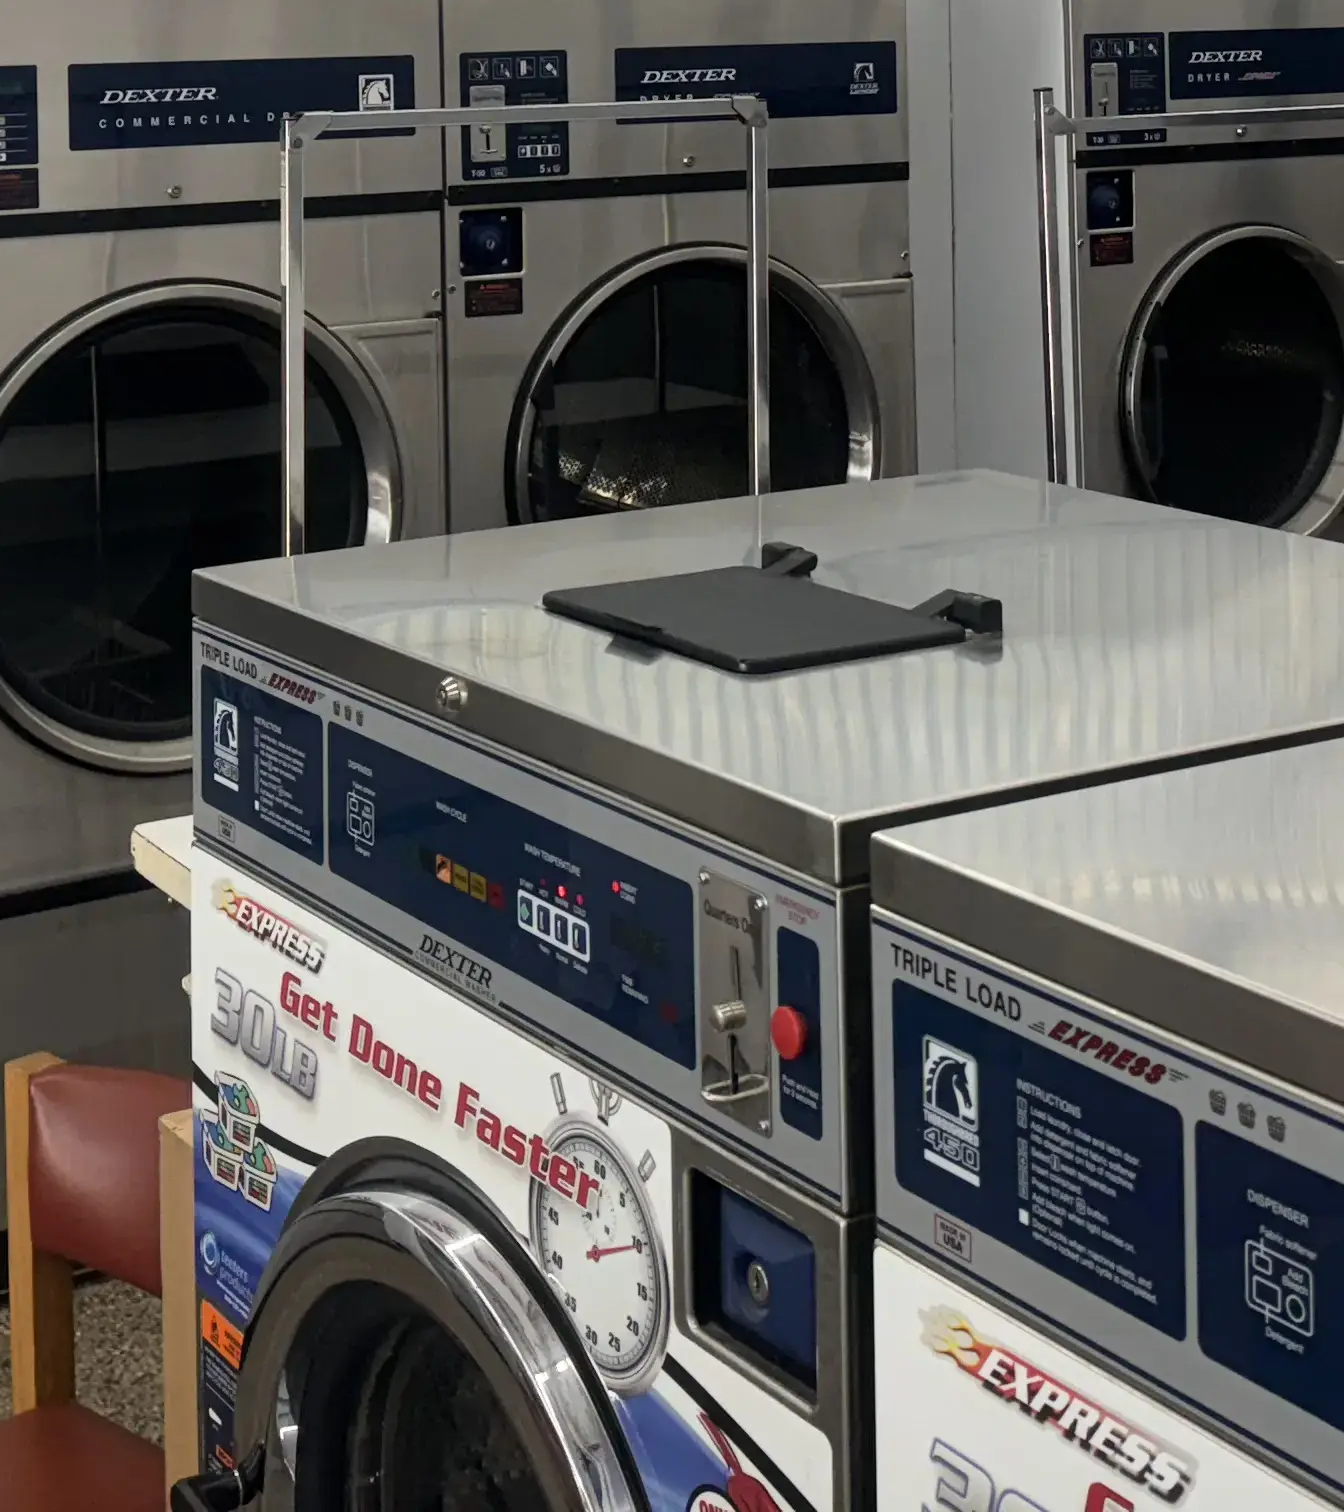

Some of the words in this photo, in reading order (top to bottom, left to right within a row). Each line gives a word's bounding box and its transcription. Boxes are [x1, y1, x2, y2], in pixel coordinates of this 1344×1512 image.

[1188, 50, 1263, 63] DEXTER
[640, 68, 737, 84] DEXTER
[1188, 73, 1230, 83] DRYER
[99, 86, 219, 105] DEXTER
[98, 112, 251, 130] COMMERCIAL
[200, 641, 230, 668] TRIPLE
[232, 655, 258, 679] LOAD
[267, 673, 318, 705] EXPRESS
[235, 898, 326, 973] EXPRESS
[419, 934, 492, 989] DEXTER
[415, 950, 463, 985] COMMERCIAL
[465, 979, 497, 1002] WASHER
[890, 942, 958, 996] TRIPLE
[964, 976, 1022, 1023] LOAD
[1047, 1019, 1169, 1086] EXPRESS
[210, 966, 319, 1100] 30LB
[280, 971, 339, 1042] Get
[348, 1013, 443, 1112] Done
[455, 1082, 600, 1209] Faster
[1016, 1078, 1082, 1119] INSTRUCTIONS
[924, 1126, 980, 1173] 450
[594, 1159, 606, 1180] 60
[619, 1192, 626, 1208] 5
[1247, 1188, 1309, 1229] DISPENSER
[547, 1207, 560, 1226] 45
[631, 1235, 643, 1255] 10
[943, 1233, 964, 1255] USA
[551, 1250, 563, 1270] 40
[1288, 1268, 1304, 1284] Add
[564, 1292, 577, 1313] 35
[636, 1282, 648, 1302] 15
[585, 1324, 598, 1347] 30
[626, 1315, 639, 1337] 20
[608, 1332, 621, 1353] 25
[1265, 1325, 1304, 1355] Detergent
[978, 1348, 1193, 1500] EXPRESS
